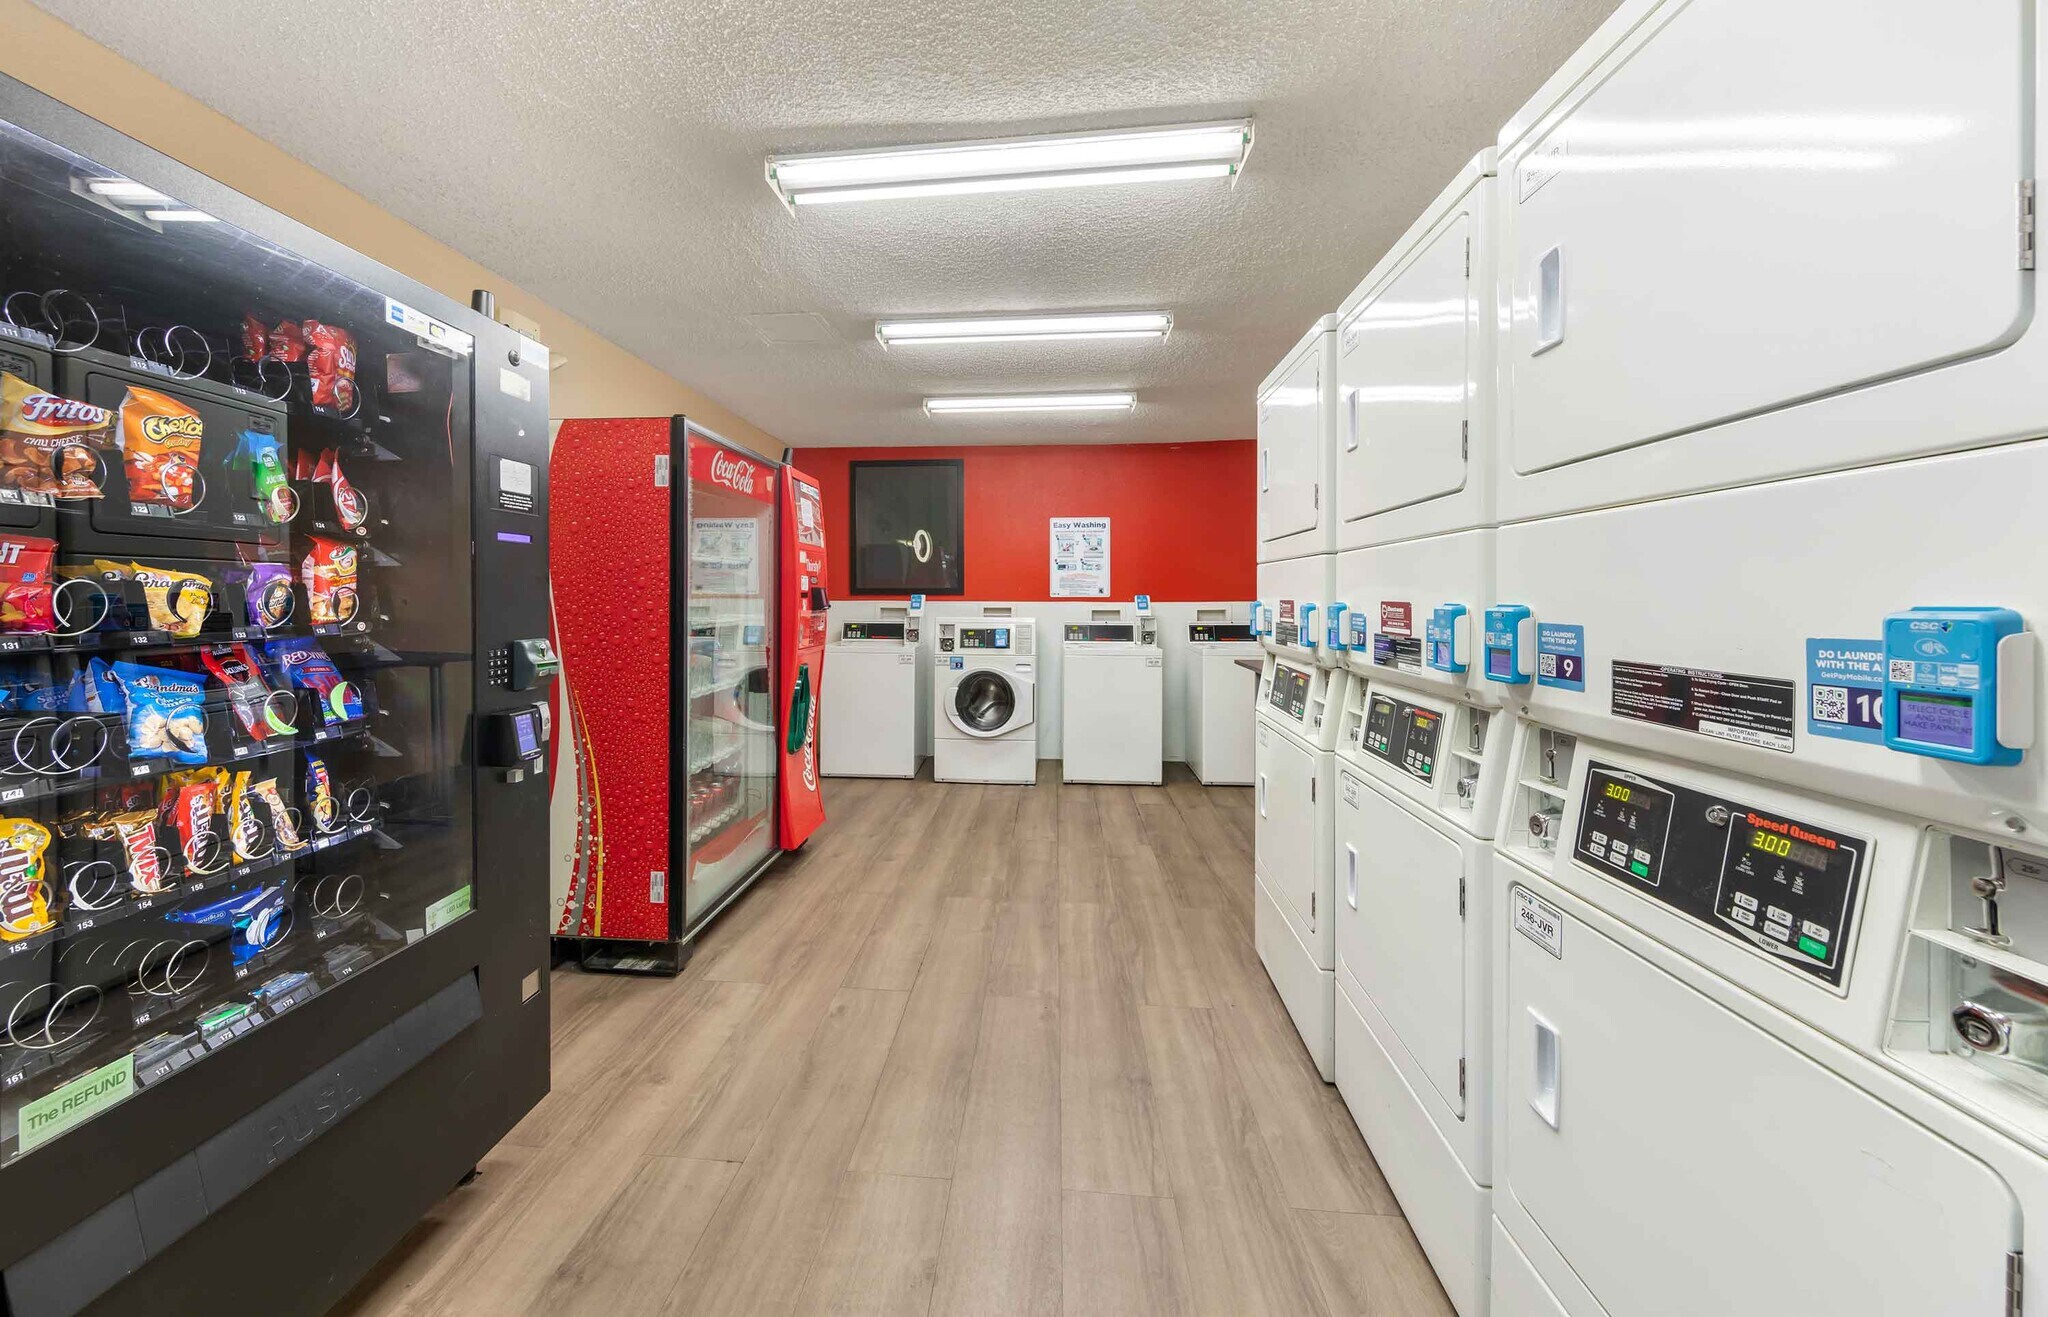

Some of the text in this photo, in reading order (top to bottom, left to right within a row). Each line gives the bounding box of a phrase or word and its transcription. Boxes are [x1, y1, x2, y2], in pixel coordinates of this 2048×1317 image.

[133, 360, 147, 369] 112
[235, 387, 247, 395] 113
[22, 393, 106, 422] Fritos
[23, 434, 84, 447] CHILI CHEESE
[711, 450, 755, 494] Coca-Cola
[1, 491, 18, 499] 121
[1073, 521, 1107, 529] Washing
[315, 627, 326, 635] 134
[1910, 621, 1939, 630] CSC
[133, 636, 148, 644] 132
[1359, 634, 1364, 644] 7
[2, 642, 19, 650] 131
[282, 651, 308, 666] RED
[1818, 650, 1835, 659] DO
[1563, 658, 1574, 678] 9
[1815, 659, 1883, 672] WITH THE A
[1661, 666, 1686, 675] OPERATING
[1688, 670, 1724, 679] INSTRUCTIONS
[1908, 703, 1937, 714] SELECT
[1915, 713, 1935, 722] AND
[1903, 719, 1929, 729] MAKE
[1727, 727, 1760, 738] IMPORTANT:
[802, 696, 818, 792] Coca-Cola
[1743, 736, 1761, 744] BEFORE
[1623, 773, 1637, 781] UPPER
[1606, 783, 1630, 802] 3.00
[1747, 812, 1838, 850] Speed Queen
[1752, 831, 1792, 857] 3.00
[127, 824, 161, 886] TWIX
[281, 853, 292, 861] 157
[238, 868, 251, 876] 156
[2022, 862, 2042, 875] 25¢
[191, 883, 204, 892] 155
[1516, 890, 1528, 901] CSC
[138, 900, 153, 910] 154
[77, 920, 94, 931] 153
[1520, 907, 1554, 937] 246-JVR
[316, 931, 327, 939] 164
[9, 942, 28, 954] 152
[1758, 937, 1779, 951] LOWER
[342, 967, 353, 976] 174
[135, 1013, 150, 1025] 162
[219, 1031, 234, 1042] 172
[155, 1065, 170, 1077] 171
[5, 1072, 25, 1086] 161
[27, 1070, 127, 1130] The REFUND
